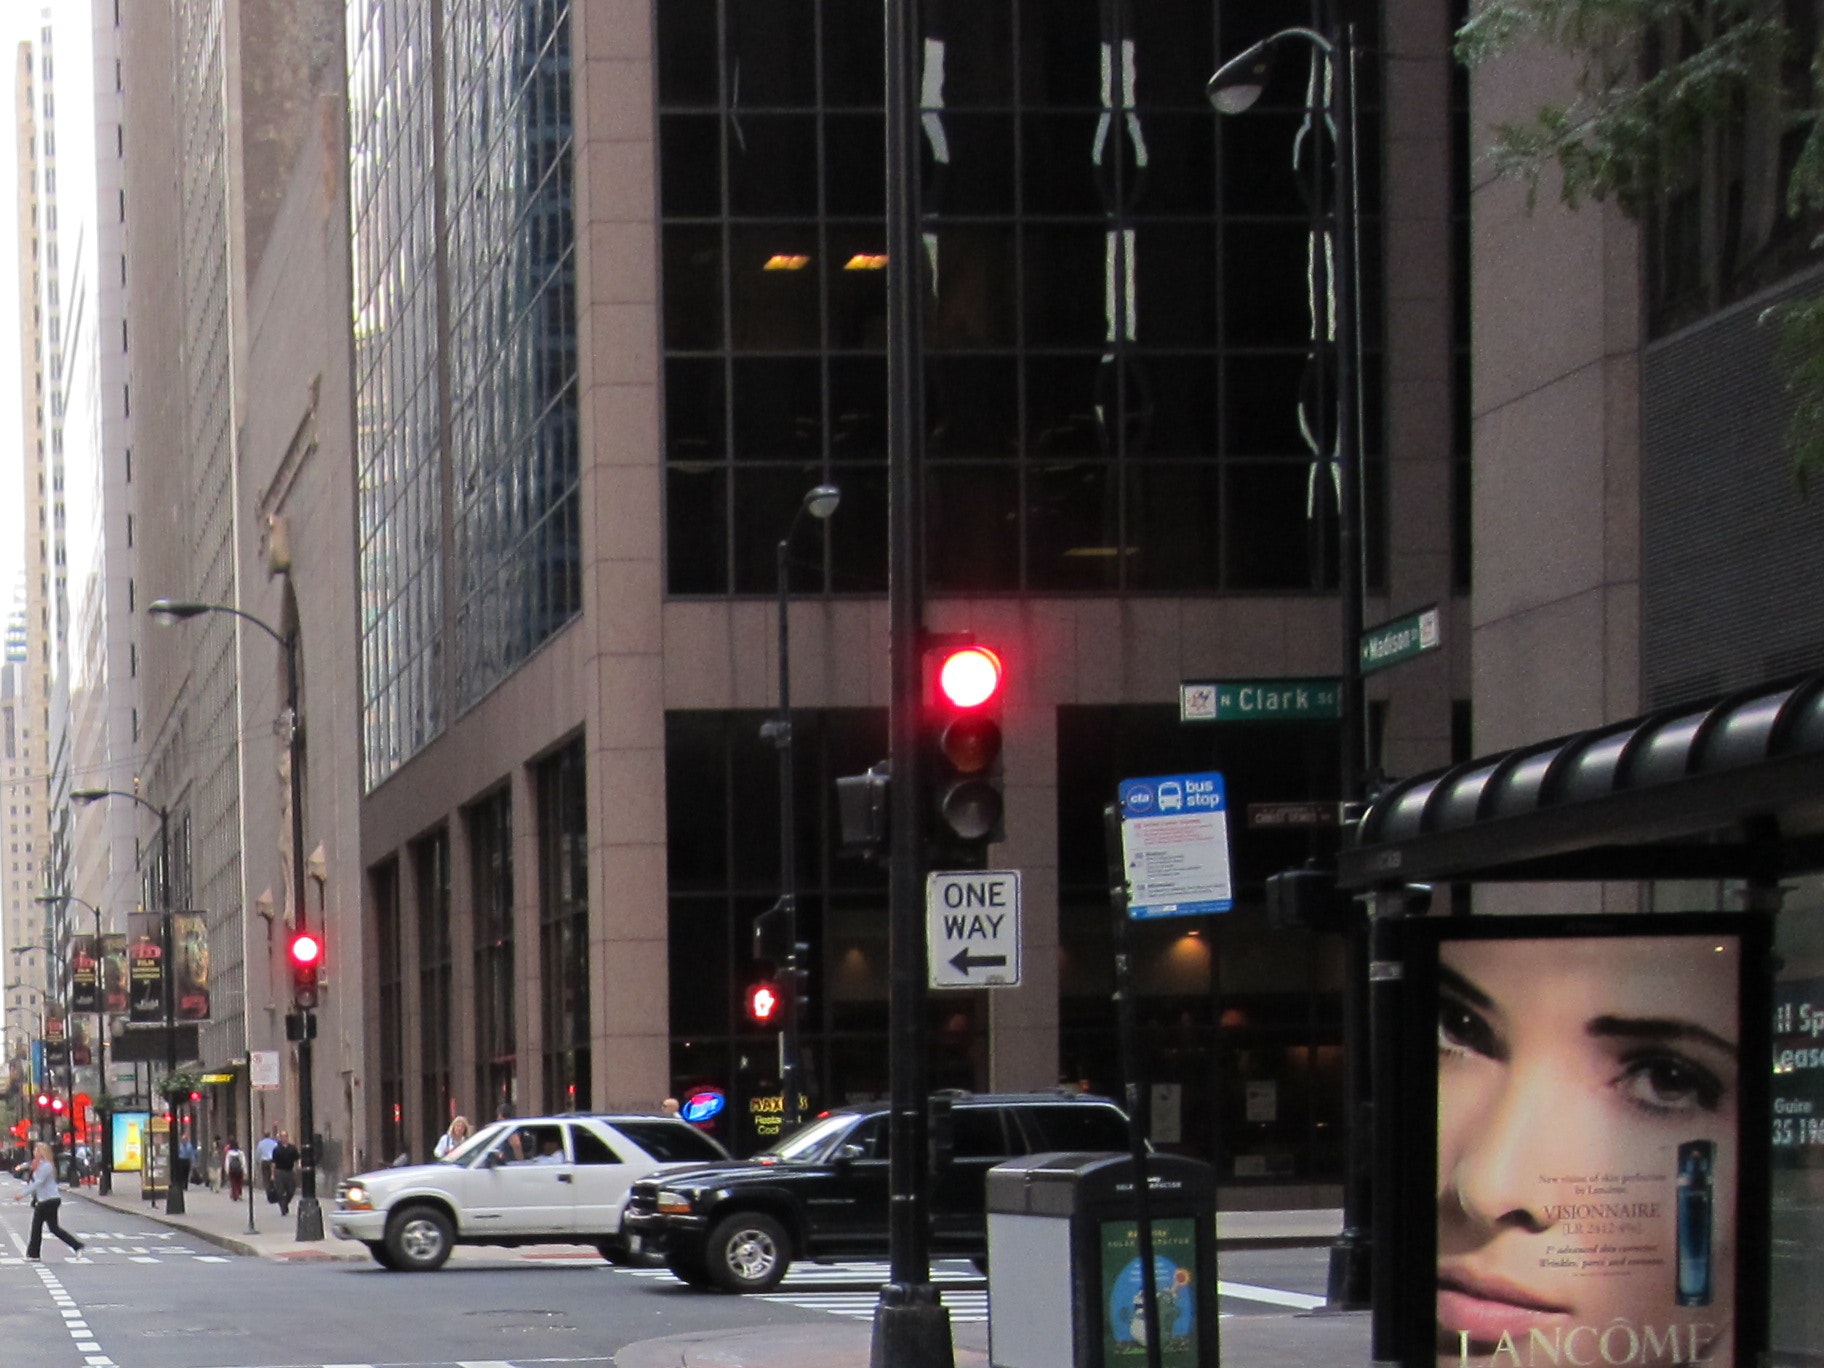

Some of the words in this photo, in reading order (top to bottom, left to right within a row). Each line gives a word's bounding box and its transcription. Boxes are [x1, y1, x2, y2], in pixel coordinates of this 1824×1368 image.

[1370, 630, 1410, 660] Madison
[1239, 687, 1309, 711] Clark
[1185, 780, 1213, 794] bus
[1130, 793, 1150, 804] cta
[1186, 793, 1220, 809] stop
[943, 882, 1007, 909] ONE
[943, 914, 1005, 940] WAY
[1542, 1203, 1662, 1220] VISIONNAIRE
